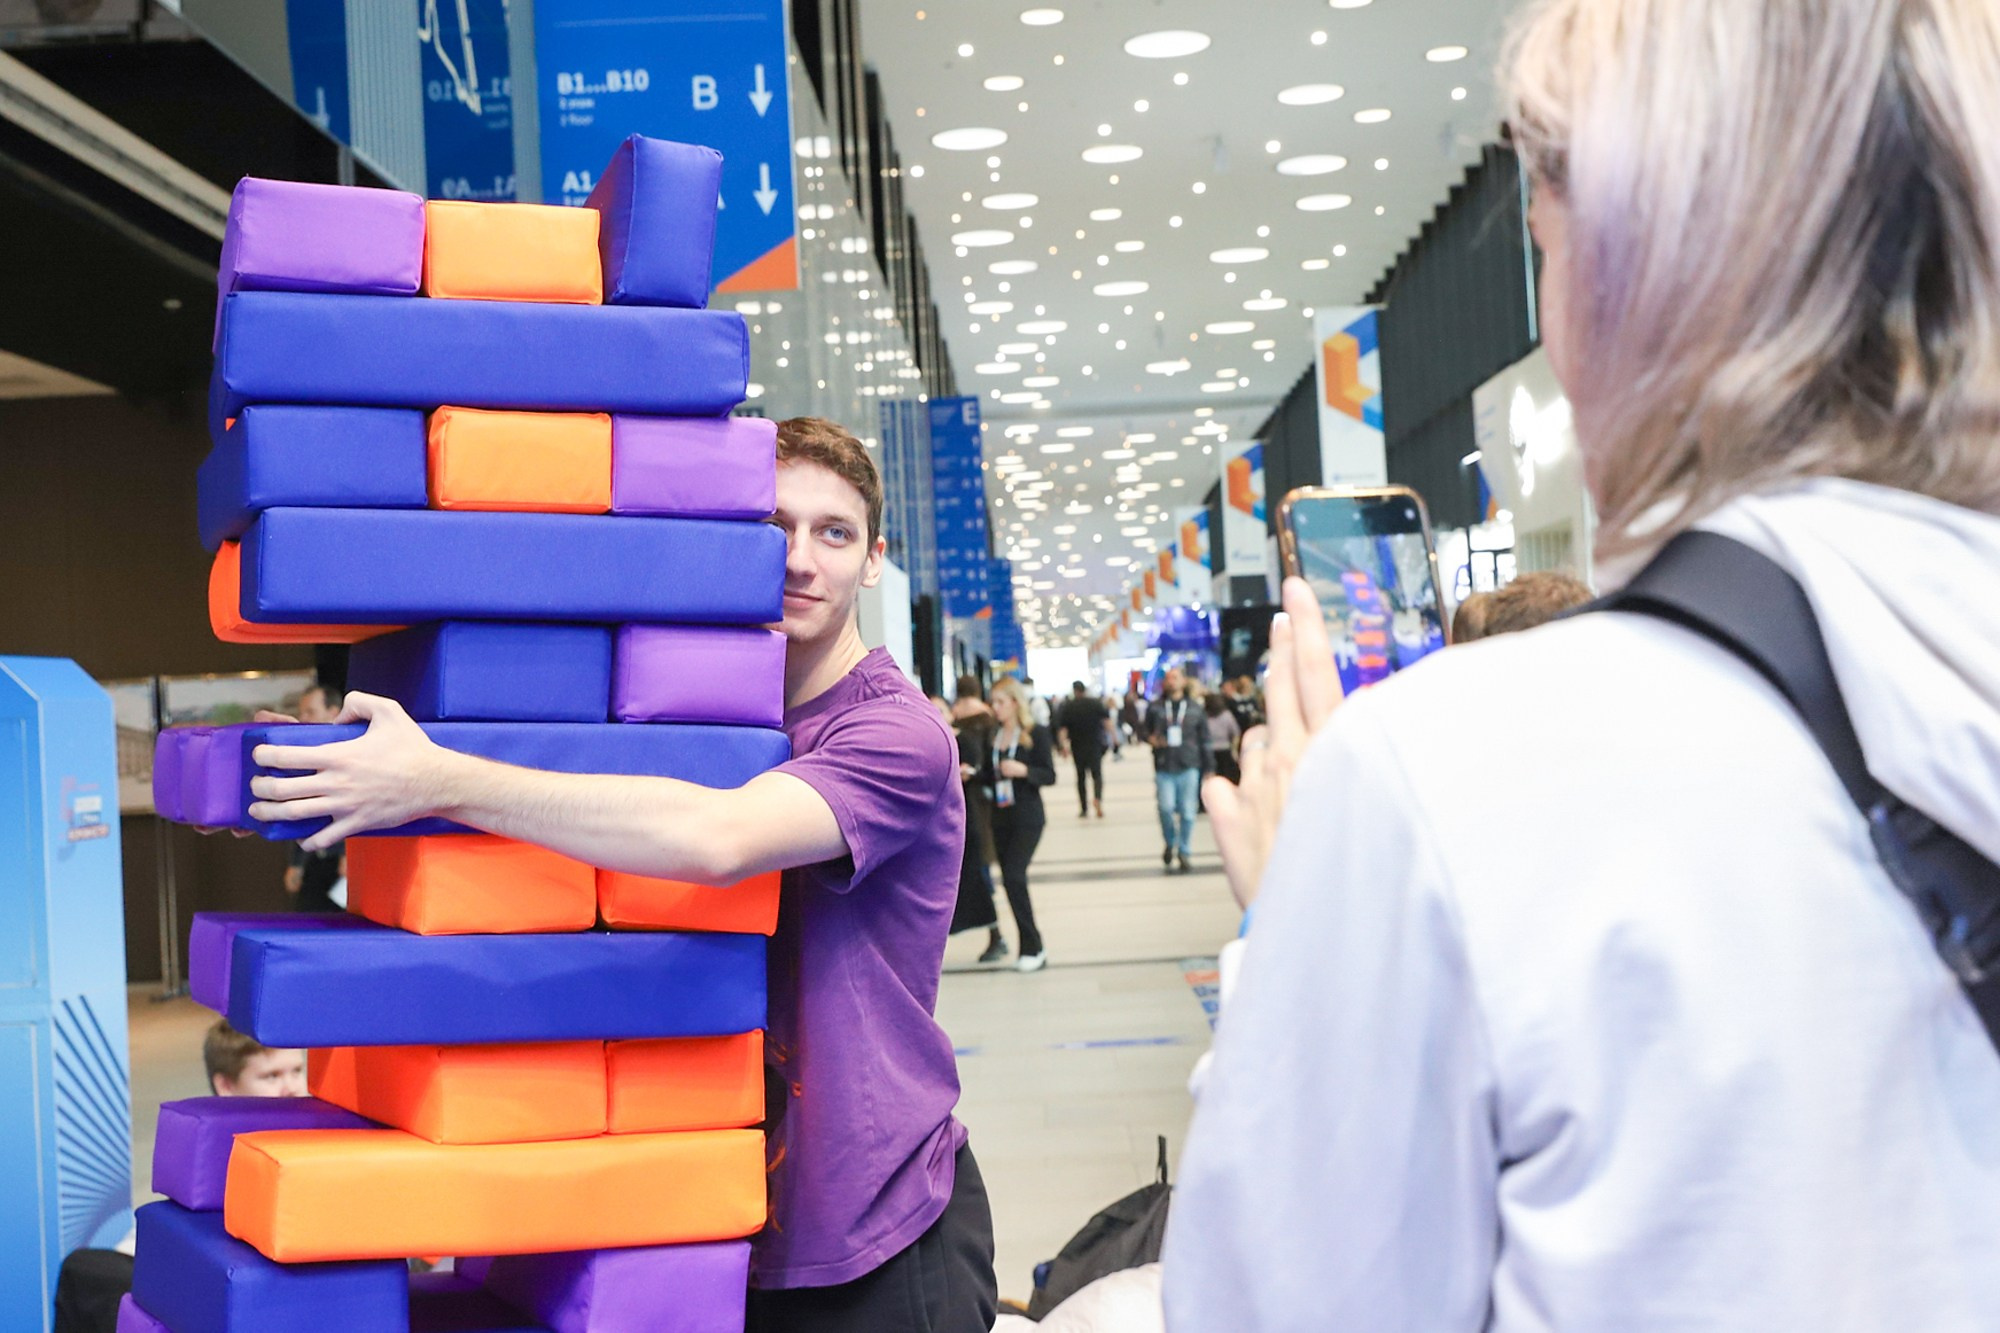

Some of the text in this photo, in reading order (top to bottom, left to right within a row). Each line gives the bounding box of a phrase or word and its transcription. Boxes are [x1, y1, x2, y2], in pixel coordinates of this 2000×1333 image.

[557, 68, 649, 95] B1...B10
[691, 74, 719, 111] B
[962, 401, 978, 426] E
